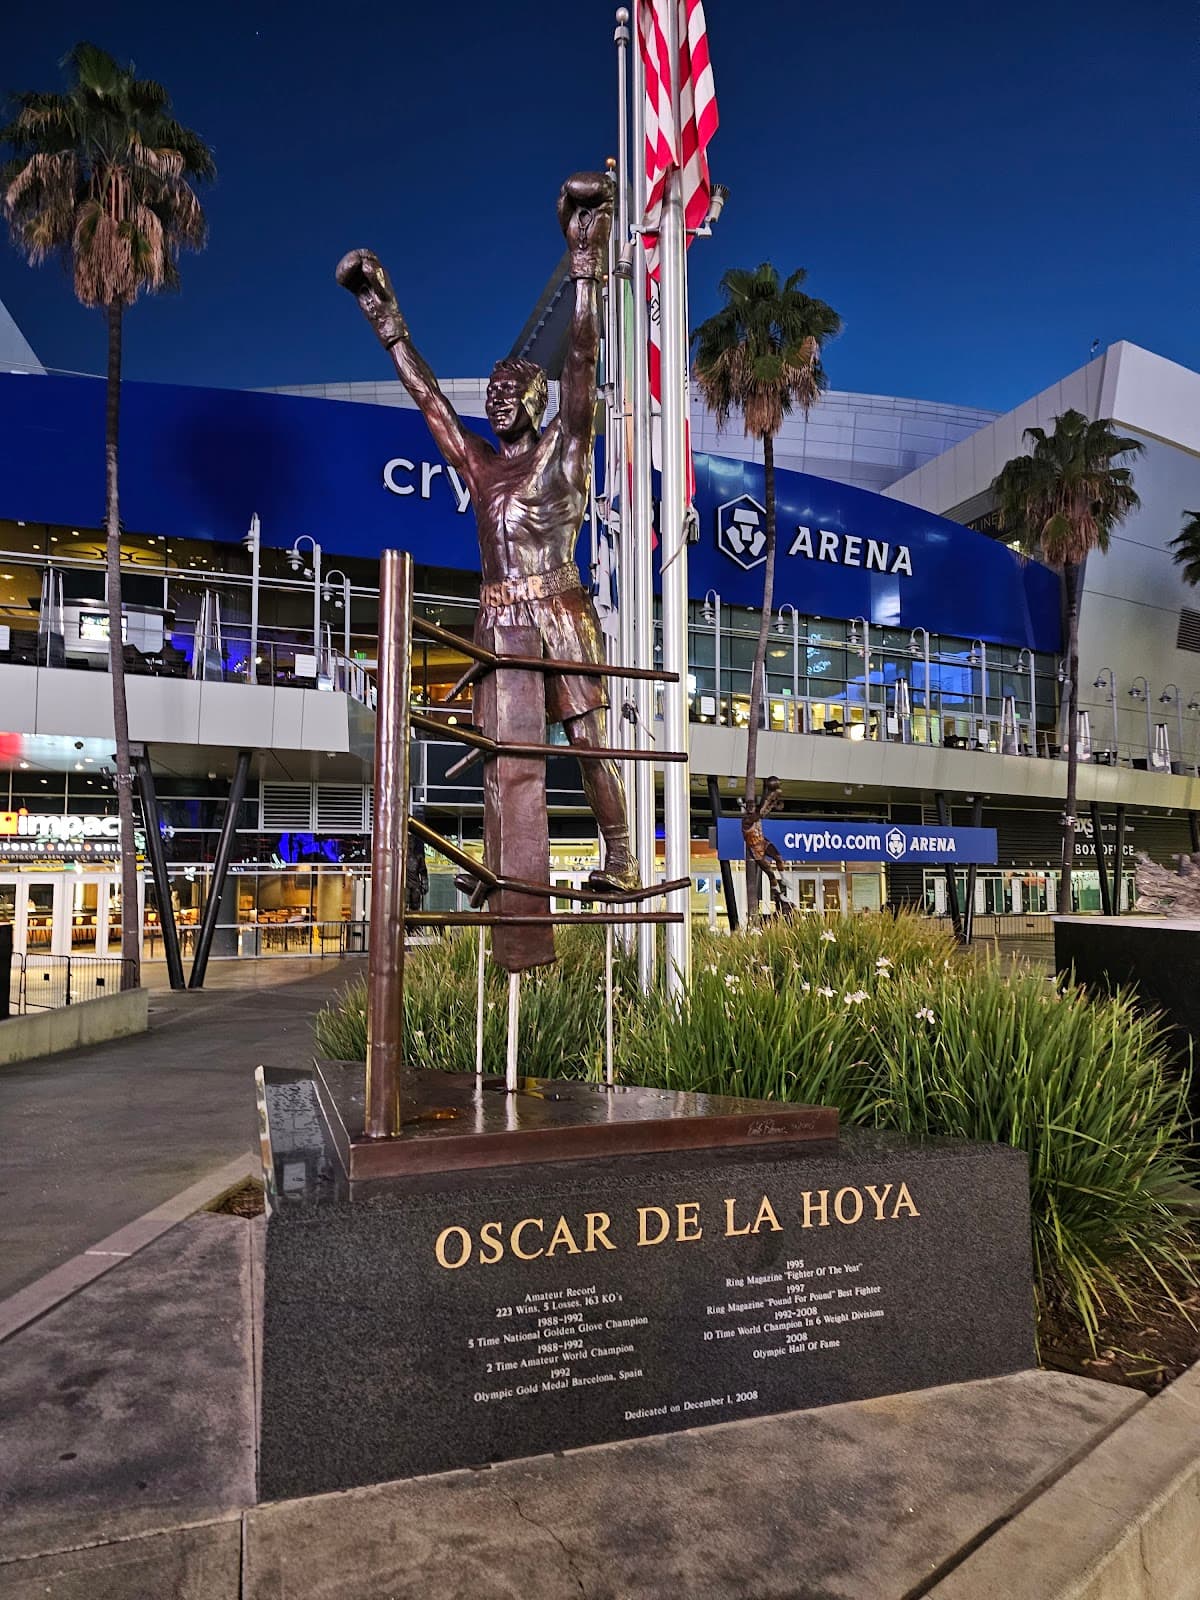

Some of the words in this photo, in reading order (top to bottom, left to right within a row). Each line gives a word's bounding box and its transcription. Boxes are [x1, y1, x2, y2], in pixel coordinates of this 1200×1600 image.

[383, 458, 470, 513] cry
[788, 526, 913, 576] ARENA
[18, 808, 121, 841] impac
[0, 843, 45, 852] PORTS
[58, 843, 81, 852] BAR
[94, 843, 121, 852] GRIL
[784, 831, 881, 852] crypto.com
[910, 836, 956, 852] ARENA
[1075, 844, 1096, 855] BOX
[1103, 844, 1134, 855] OFCE
[435, 1212, 617, 1269] OSCAR
[637, 1202, 702, 1247] DE
[724, 1195, 784, 1237] LA
[801, 1182, 920, 1228] HOYA
[786, 1260, 805, 1269] 1995
[726, 1278, 745, 1287] Ring
[747, 1273, 783, 1285] Magazine
[816, 1267, 826, 1277] Of
[828, 1265, 842, 1275] The
[525, 1292, 563, 1302] Amateur
[567, 1285, 596, 1297] Record
[786, 1284, 805, 1294] 1997
[496, 1308, 512, 1317] 223
[543, 1302, 549, 1311] 5
[585, 1296, 599, 1306] 163
[601, 1292, 623, 1303] KO's
[707, 1306, 726, 1315] Ring
[727, 1301, 765, 1313] Magazine
[794, 1294, 807, 1303] For
[837, 1288, 853, 1298] Best
[855, 1285, 882, 1296] Fighter
[538, 1313, 583, 1327] 1988-1992
[774, 1306, 818, 1320] 1992-2008
[468, 1338, 474, 1348] 5
[477, 1336, 500, 1347] Time
[503, 1329, 541, 1343] National
[543, 1325, 575, 1338] Golden
[578, 1321, 603, 1333] Glove
[605, 1316, 649, 1329] Champion
[703, 1331, 713, 1341] 10
[716, 1329, 736, 1339] Time
[738, 1324, 761, 1335] World
[763, 1319, 803, 1332] Champion
[805, 1317, 814, 1326] In
[816, 1316, 822, 1325] 6
[823, 1313, 849, 1324] Weight
[851, 1308, 885, 1320] Divisions
[538, 1339, 583, 1354] 1988-1992
[753, 1347, 786, 1359] Olympic
[788, 1343, 805, 1353] Hall
[807, 1341, 818, 1351] Of
[820, 1339, 841, 1349] Fame
[785, 1333, 808, 1344] 2008
[486, 1363, 493, 1373] 2
[494, 1360, 518, 1371] Time
[520, 1356, 559, 1368] Amateur
[562, 1350, 588, 1361] World
[590, 1343, 634, 1357] Champion
[550, 1368, 571, 1379] 1992
[473, 1388, 513, 1403] Olympic
[516, 1384, 539, 1395] Gold
[541, 1379, 569, 1391] Medal
[619, 1368, 643, 1381] Spain
[624, 1405, 668, 1420] Dedicated
[670, 1405, 681, 1413] on
[683, 1397, 724, 1411] December
[735, 1390, 759, 1403] 2008
